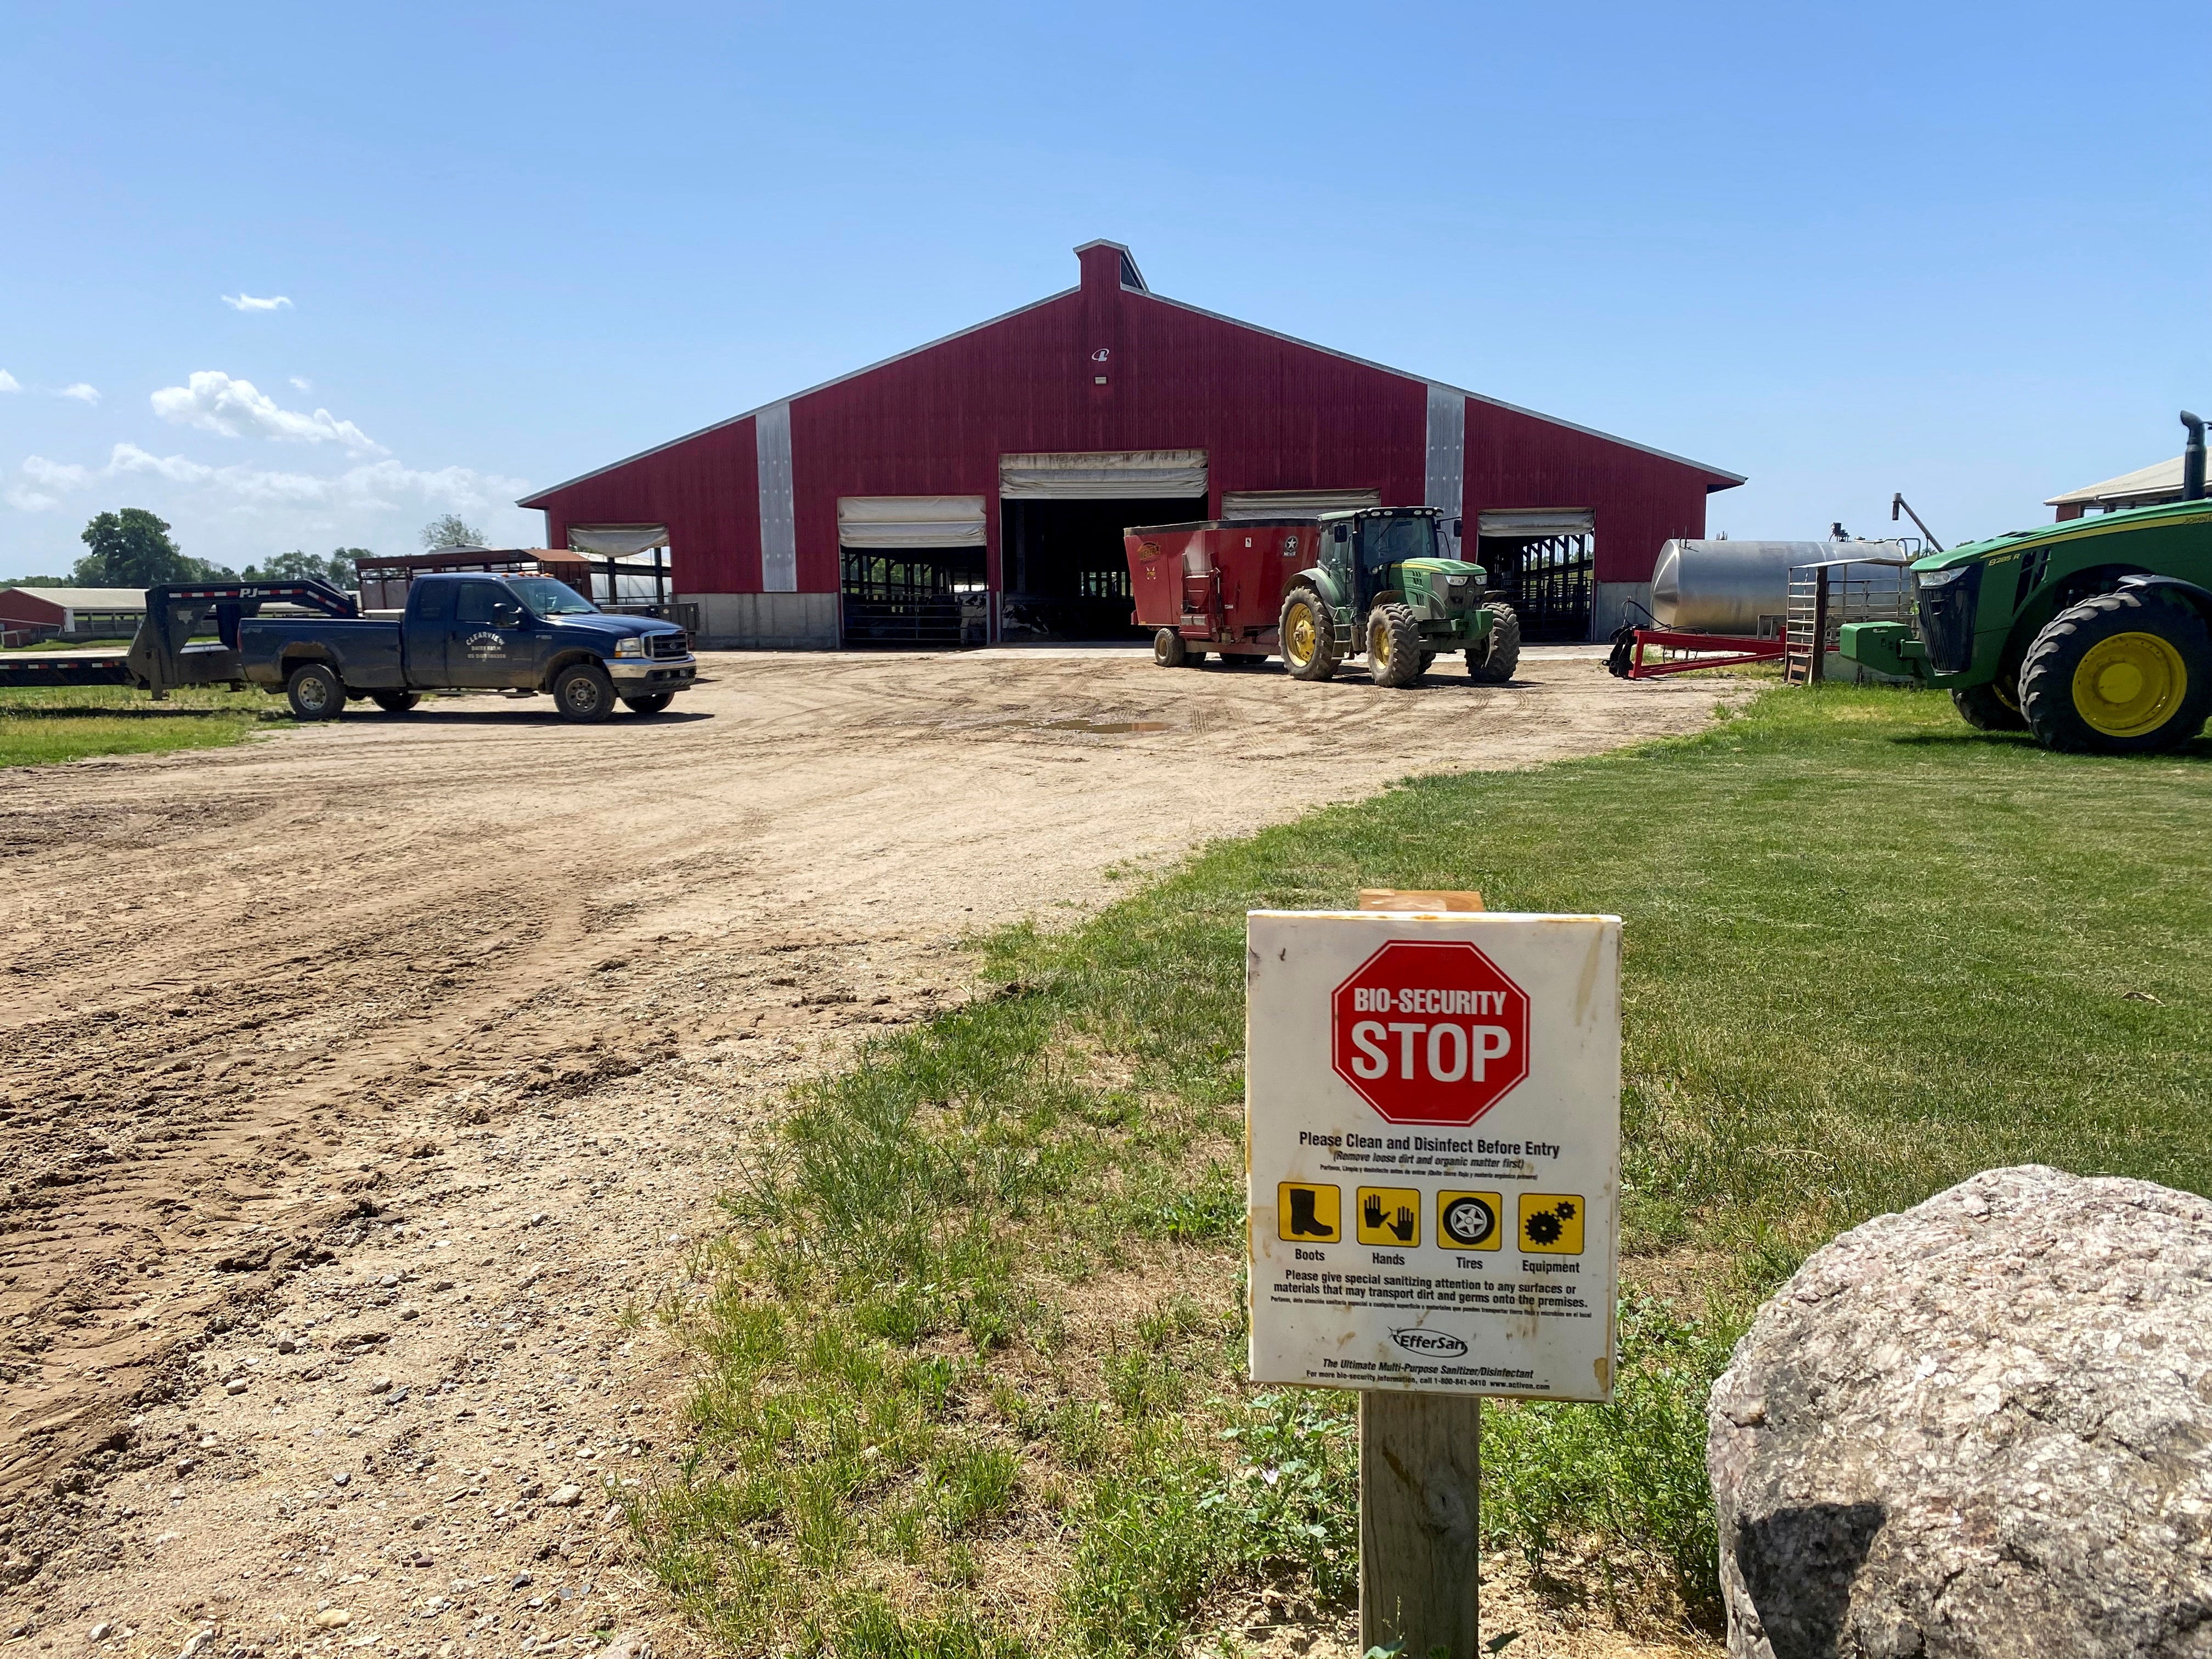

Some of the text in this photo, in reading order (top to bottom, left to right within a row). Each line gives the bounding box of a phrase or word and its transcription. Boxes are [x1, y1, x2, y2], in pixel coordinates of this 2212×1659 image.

[239, 588, 258, 598] PJ
[466, 631, 505, 645] CLEARVIEW
[1354, 988, 1507, 1015] BIO-SECURITY
[1351, 1020, 1511, 1083] STOP
[1299, 1131, 1560, 1159] Please Clean and Disinfect Before Entry
[1333, 1151, 1525, 1171] (Remove loose dirt and organic matter first)
[1295, 1249, 1325, 1261] Boots
[1372, 1252, 1406, 1266] Hands
[1456, 1256, 1483, 1269] Tires
[1522, 1260, 1580, 1274] Equipment
[1285, 1269, 1576, 1294] Please give special sanitizing attention to any surfaces or
[1274, 1283, 1588, 1308] materials that may transport dirt and germs onto the premises.
[1400, 1335, 1467, 1350] EfferSan
[1323, 1358, 1534, 1379] The Ultimate Multi-Purpose Sanitizer/Disinfectant
[1336, 1372, 1375, 1382] bio-security
[1378, 1374, 1418, 1384] information,
[1420, 1376, 1432, 1384] call
[1434, 1378, 1487, 1387] 1-800-841-0410
[1490, 1381, 1550, 1391] www.activon.com
